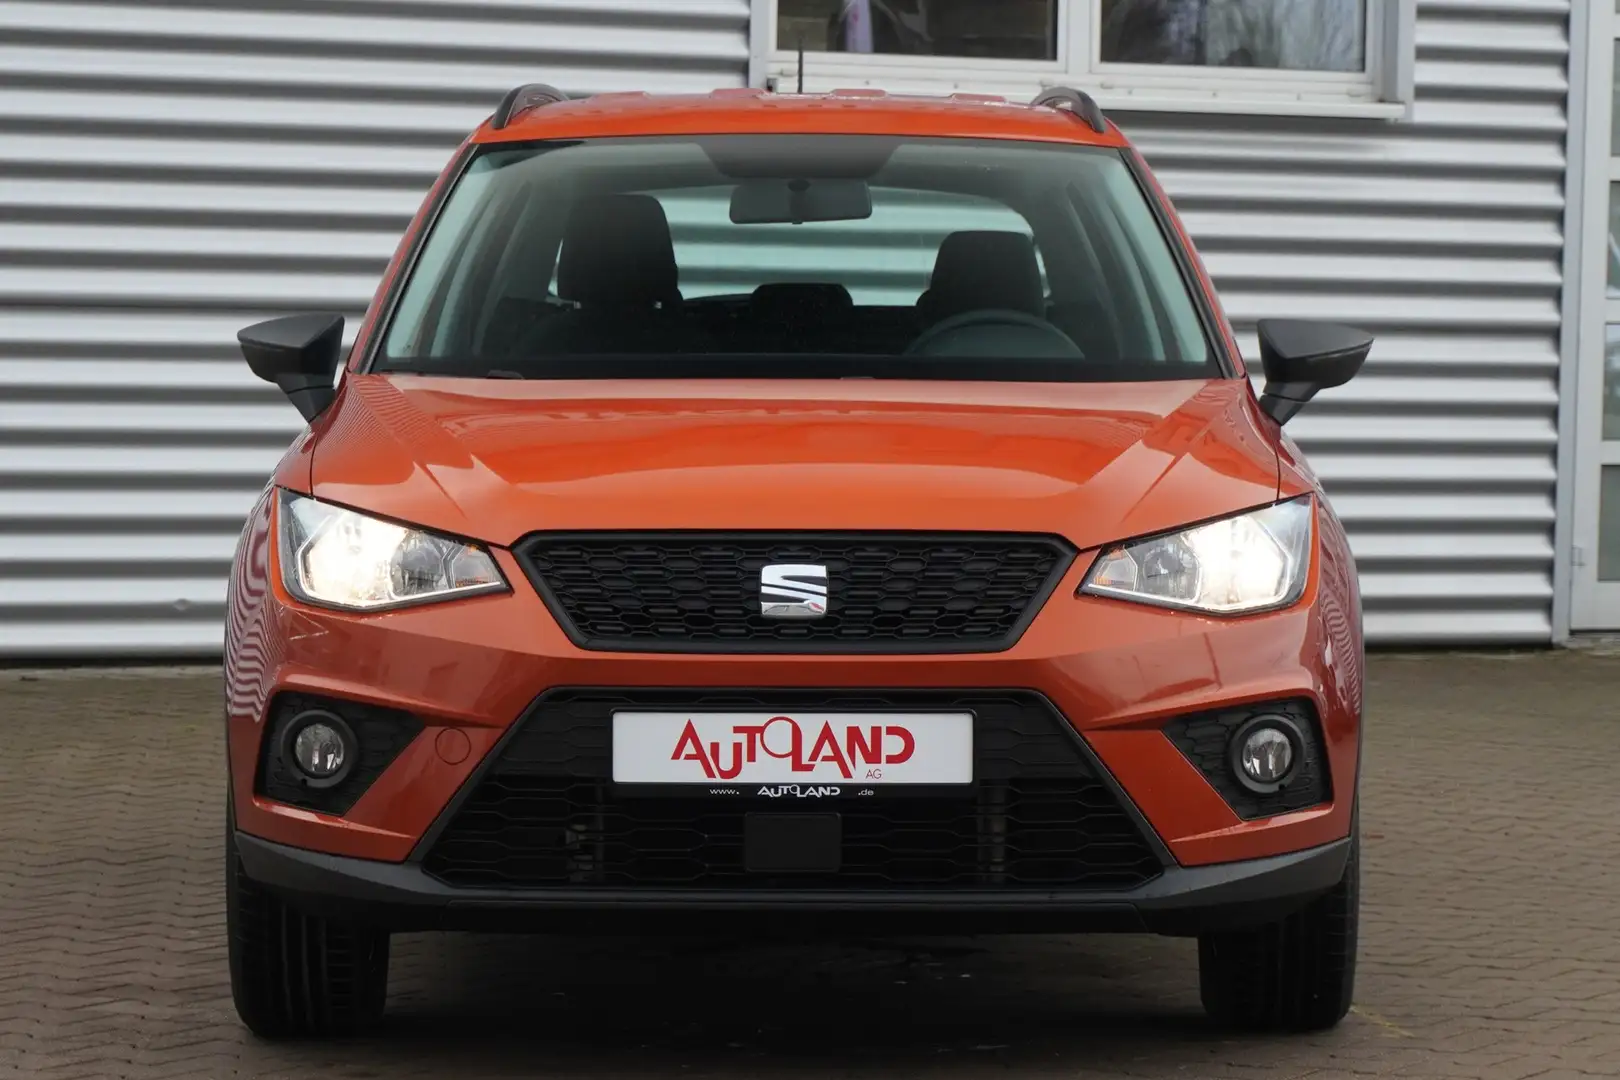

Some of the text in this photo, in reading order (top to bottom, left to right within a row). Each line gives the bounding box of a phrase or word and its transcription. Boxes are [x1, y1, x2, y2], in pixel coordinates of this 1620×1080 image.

[671, 716, 916, 780] AUTOLAND
[865, 769, 882, 780] AG
[858, 787, 874, 796] .de
